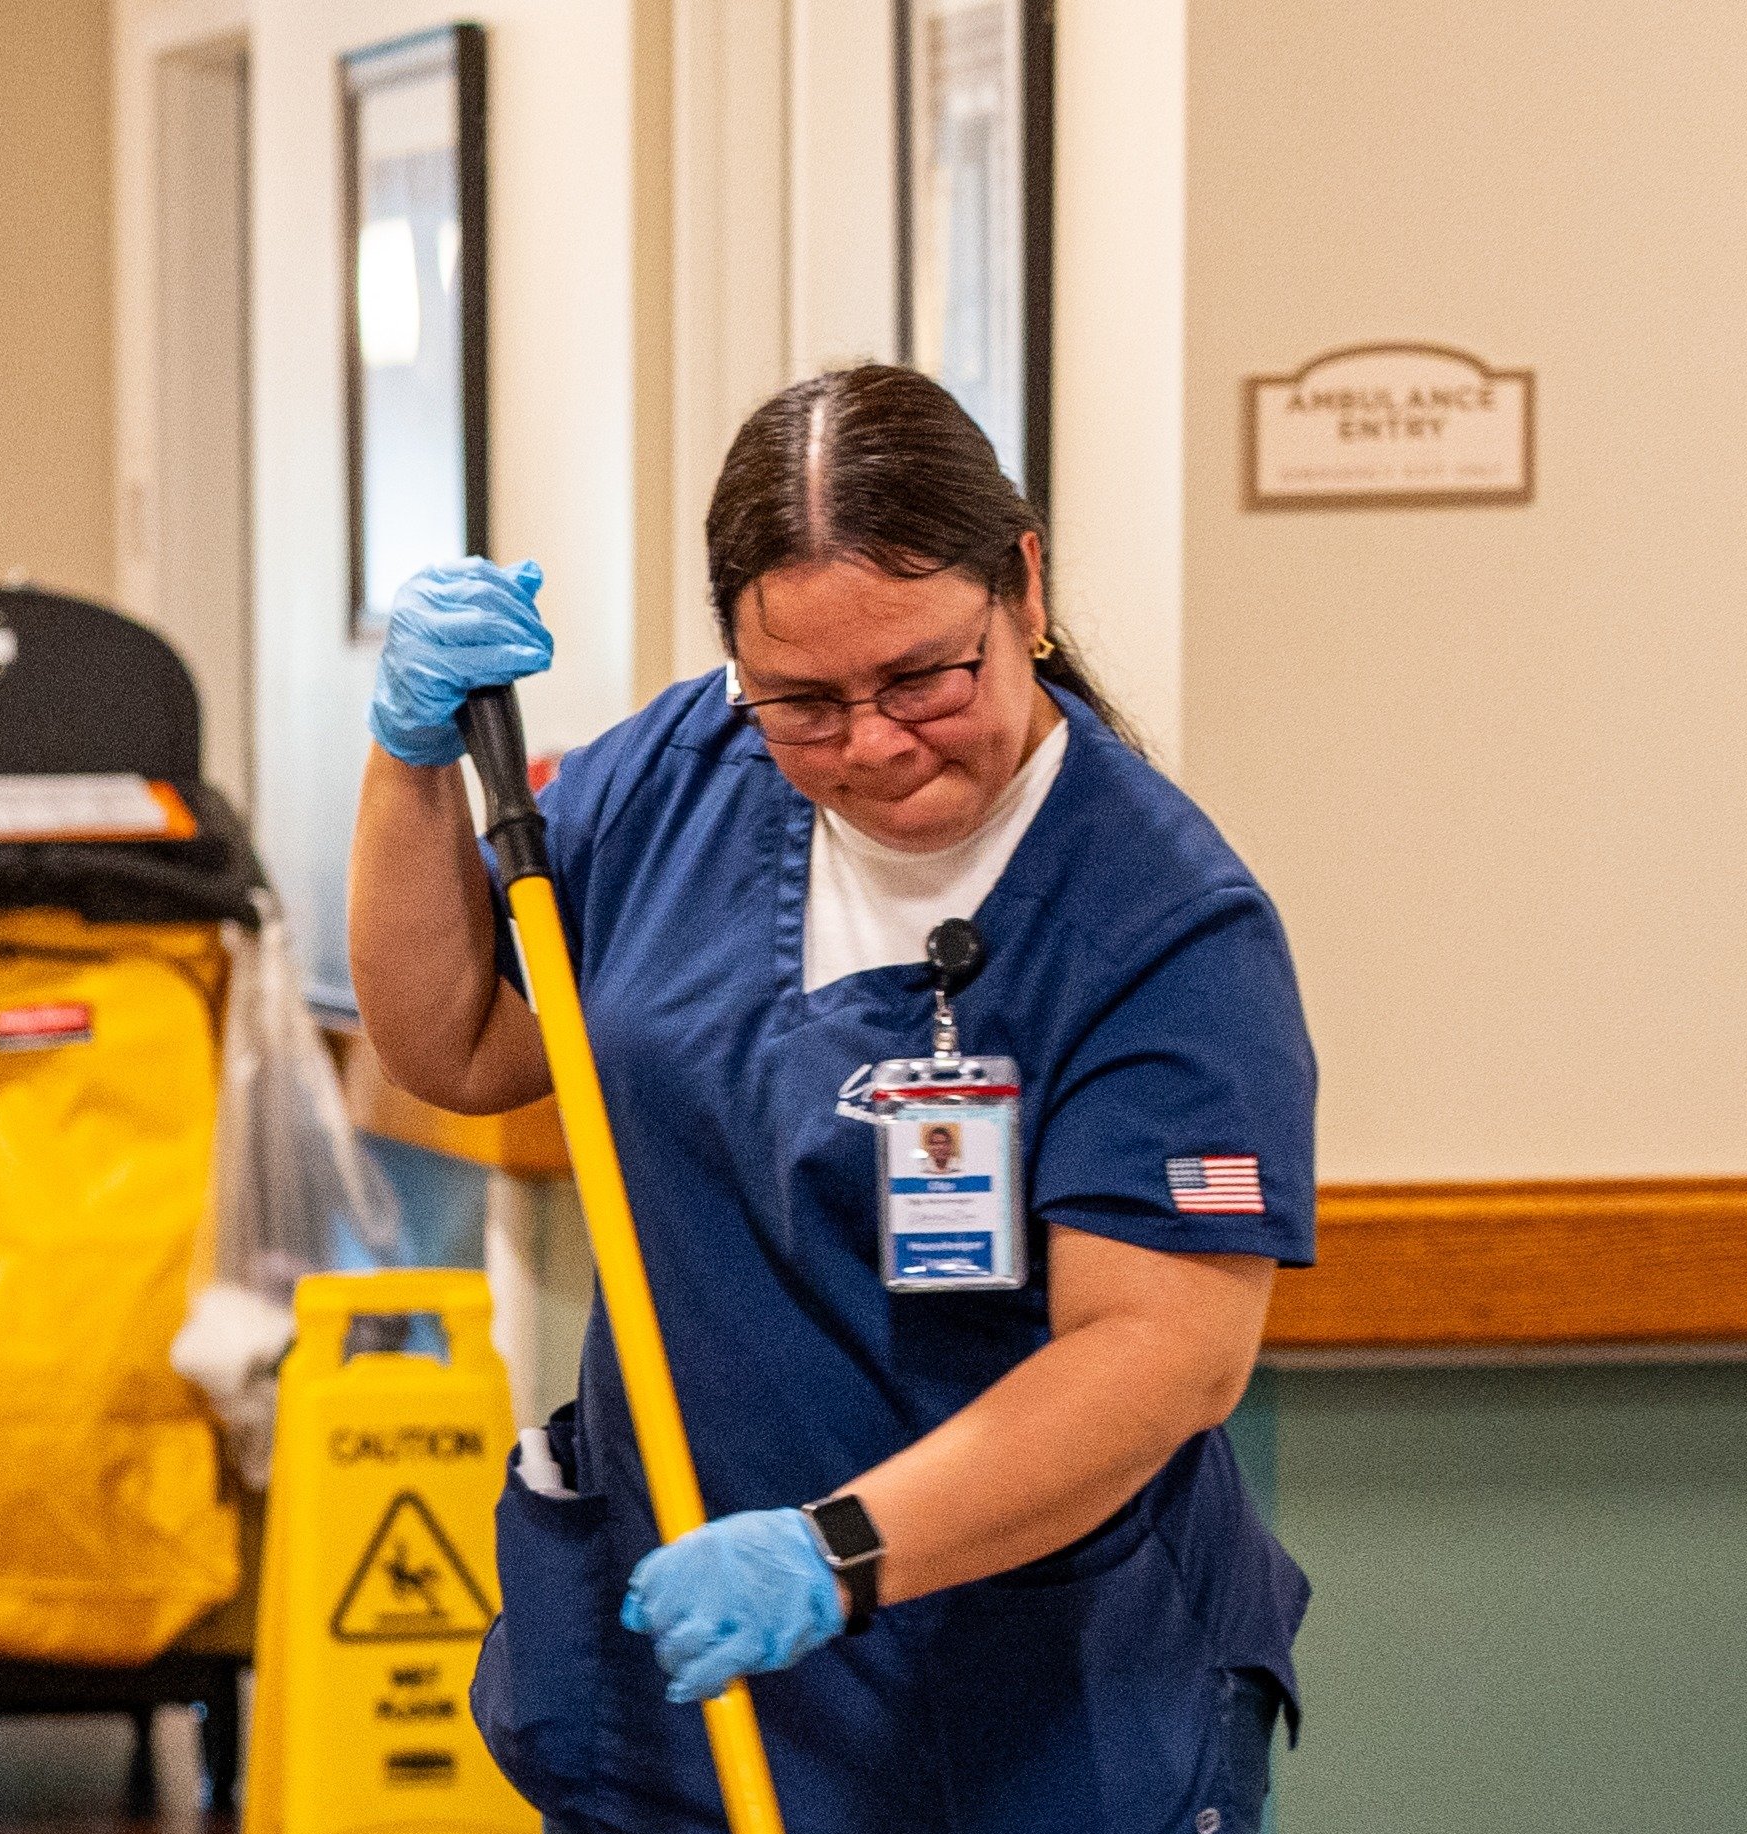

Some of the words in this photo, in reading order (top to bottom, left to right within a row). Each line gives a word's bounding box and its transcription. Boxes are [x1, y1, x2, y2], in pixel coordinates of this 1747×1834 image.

[1286, 382, 1497, 414] AMBULANCE
[1337, 416, 1448, 443] ENTRY
[330, 1424, 487, 1465] CAUTION
